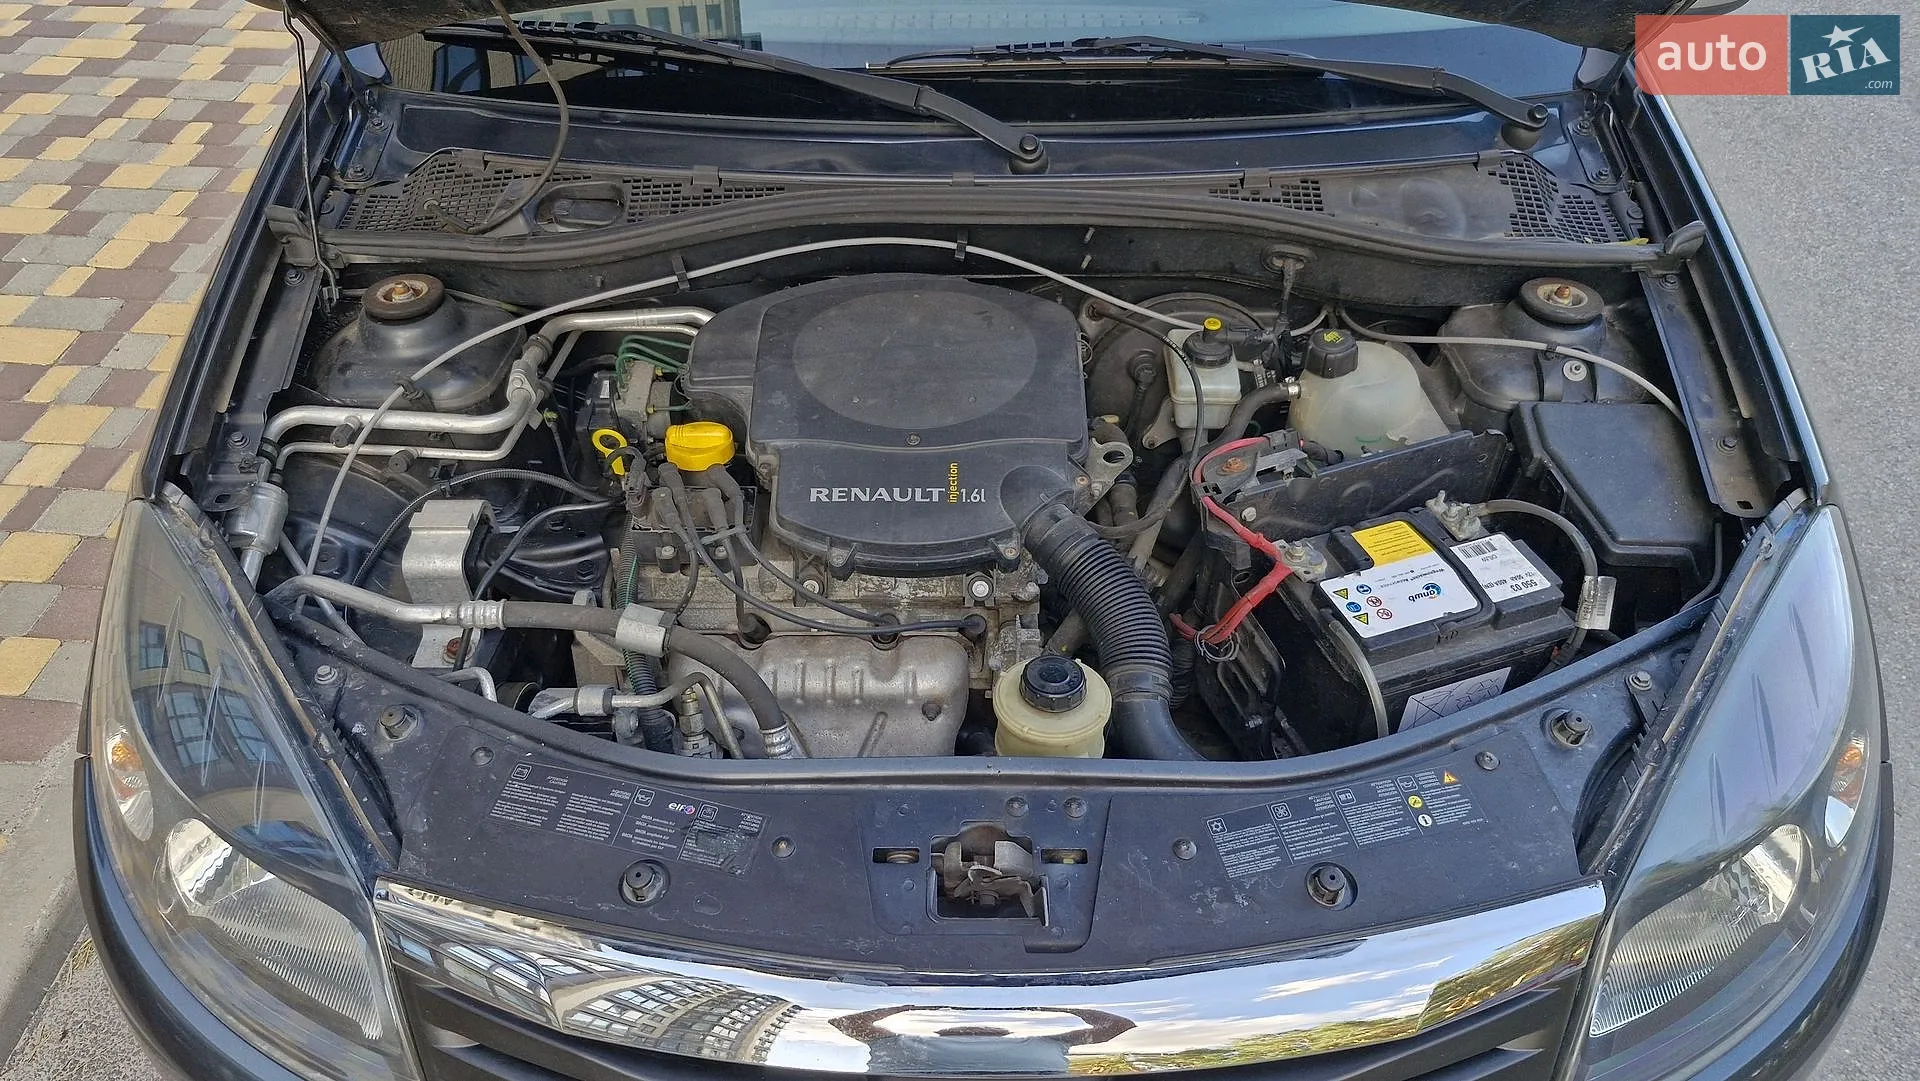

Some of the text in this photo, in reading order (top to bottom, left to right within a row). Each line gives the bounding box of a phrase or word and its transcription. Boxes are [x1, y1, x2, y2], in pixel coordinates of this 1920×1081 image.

[948, 462, 958, 503] injection
[810, 487, 944, 502] RENAULT
[1508, 579, 1538, 591] 550 03
[1406, 588, 1437, 602] anwb
